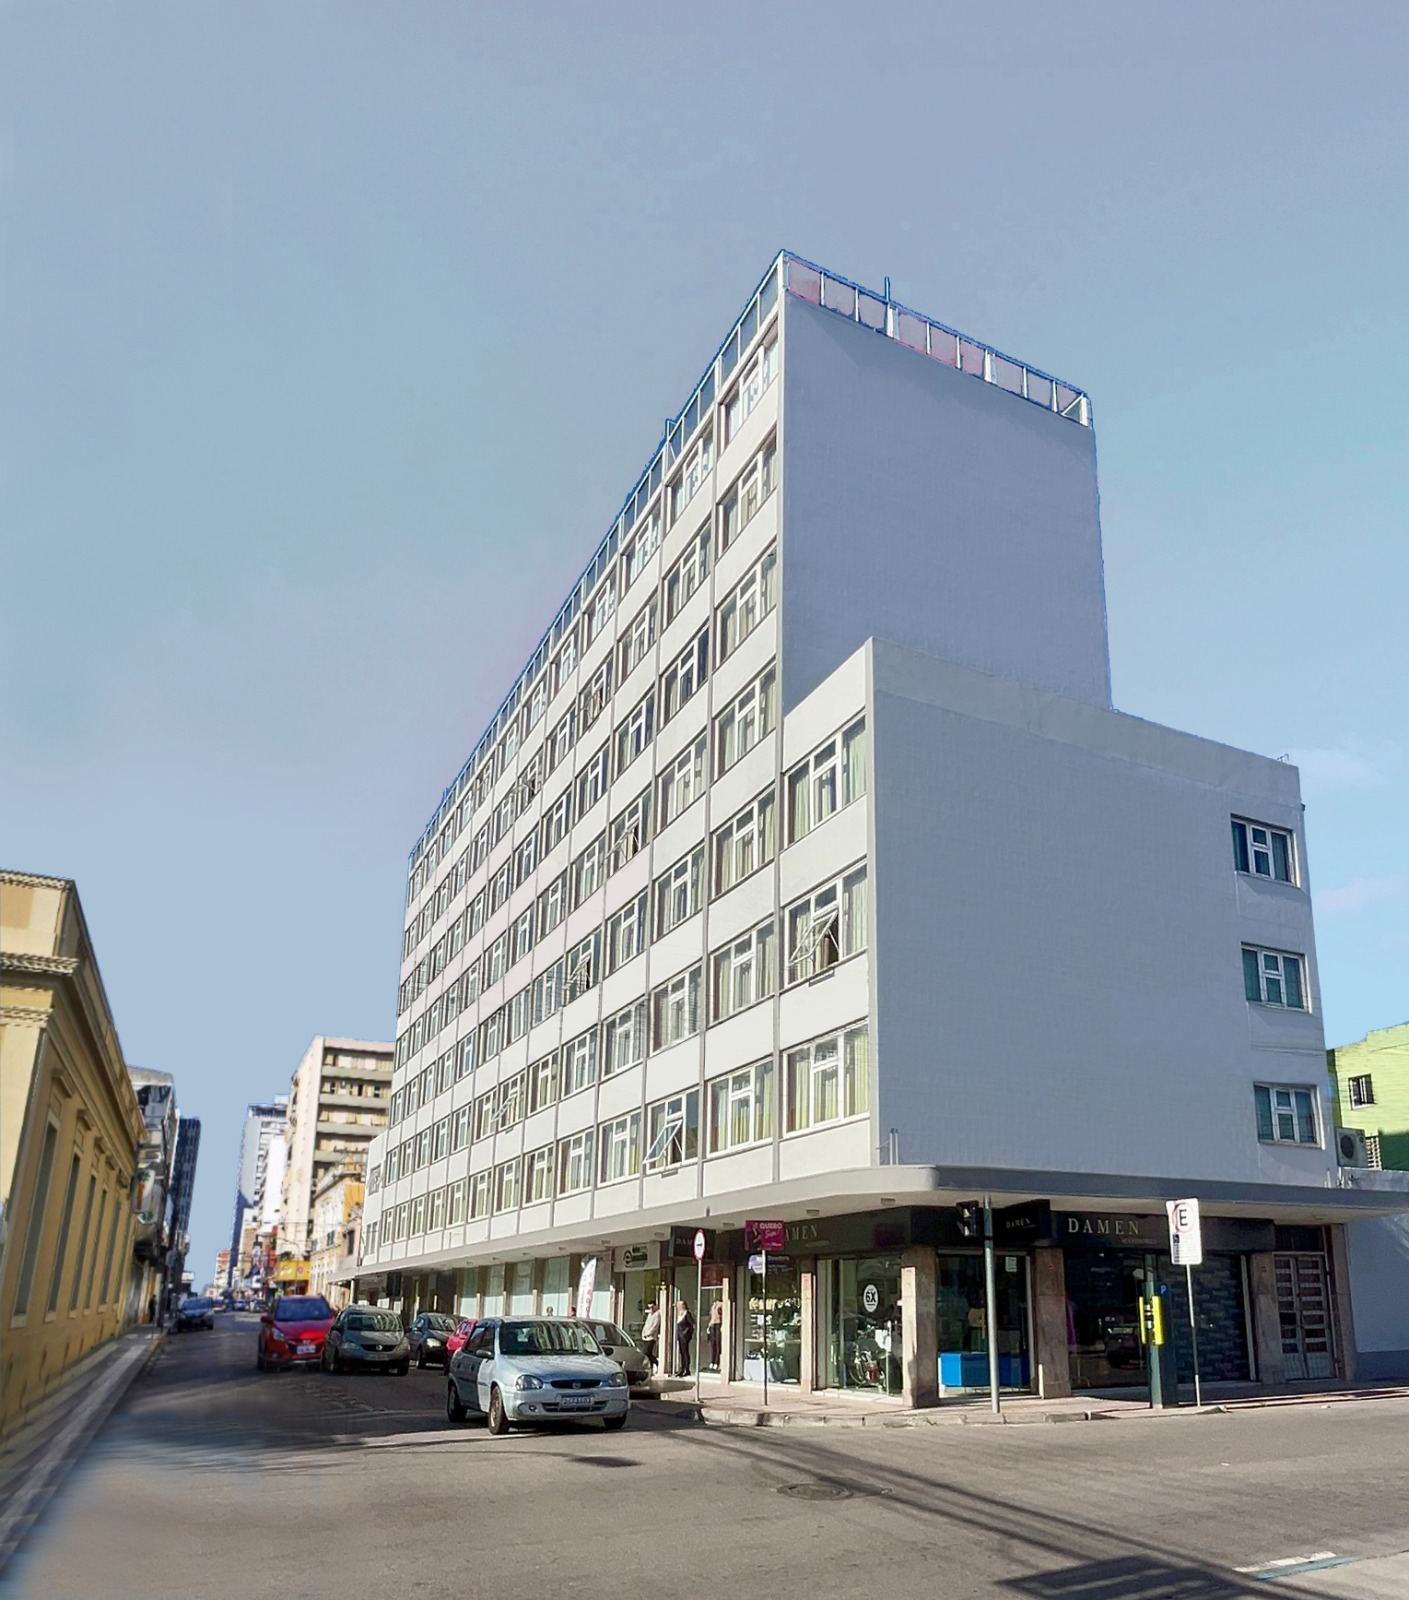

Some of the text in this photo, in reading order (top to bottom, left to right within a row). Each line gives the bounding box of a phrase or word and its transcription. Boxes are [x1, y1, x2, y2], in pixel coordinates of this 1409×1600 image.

[1179, 1209, 1188, 1226] E
[1068, 1218, 1139, 1235] DAMEN
[866, 1291, 876, 1303] 6X
